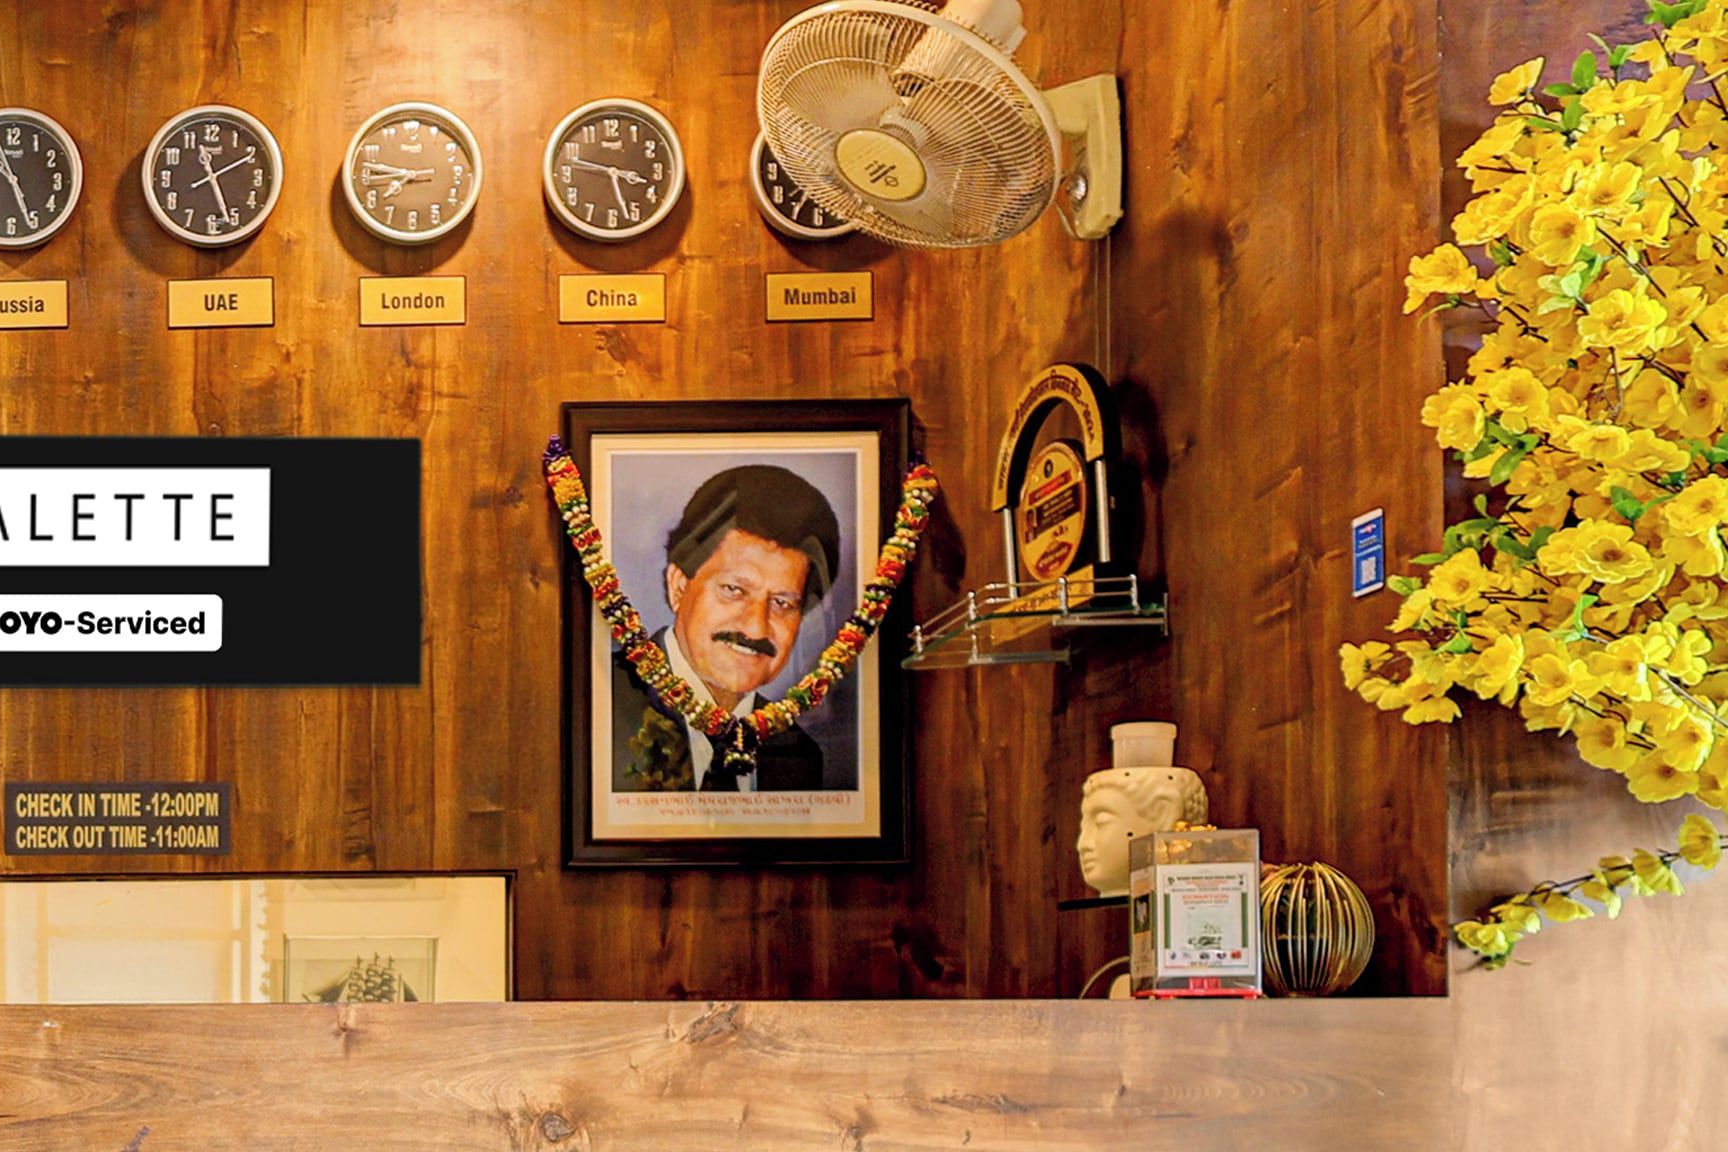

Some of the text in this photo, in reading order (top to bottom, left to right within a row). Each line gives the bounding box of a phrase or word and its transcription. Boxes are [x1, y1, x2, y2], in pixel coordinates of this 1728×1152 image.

[6, 128, 21, 145] 12
[204, 125, 220, 142] 12
[582, 125, 595, 143] 11
[603, 119, 619, 137] 12
[630, 125, 637, 142] 1
[33, 134, 39, 152] 1
[184, 132, 196, 149] 11
[232, 131, 238, 147] 1
[166, 148, 180, 165] 10
[246, 146, 256, 163] 2
[645, 140, 655, 158] 2
[47, 150, 56, 167] 2
[161, 170, 171, 188] 9
[254, 169, 263, 186] 3
[561, 166, 571, 183] 9
[653, 163, 662, 181] 3
[767, 163, 777, 180] 9
[53, 173, 62, 190] 3
[167, 192, 177, 210] 8
[246, 191, 256, 209] 4
[568, 187, 577, 206] 8
[646, 185, 656, 203] 4
[774, 186, 783, 203] 8
[45, 195, 56, 212] 4
[585, 203, 594, 222] 7
[630, 202, 640, 222] 5
[30, 211, 38, 229] 5
[185, 209, 194, 227] 7
[230, 208, 239, 226] 5
[385, 206, 394, 225] 7
[608, 209, 617, 227] 6
[814, 208, 823, 226] 6
[7, 217, 16, 235] 6
[204, 293, 239, 311] UAE
[381, 292, 445, 309] London
[586, 289, 638, 307] China
[784, 286, 856, 305] Mumbai
[15, 792, 219, 818] CHECK IN TIME -12:00PM
[15, 825, 219, 849] CHECK OUT TIME -11:00AM
